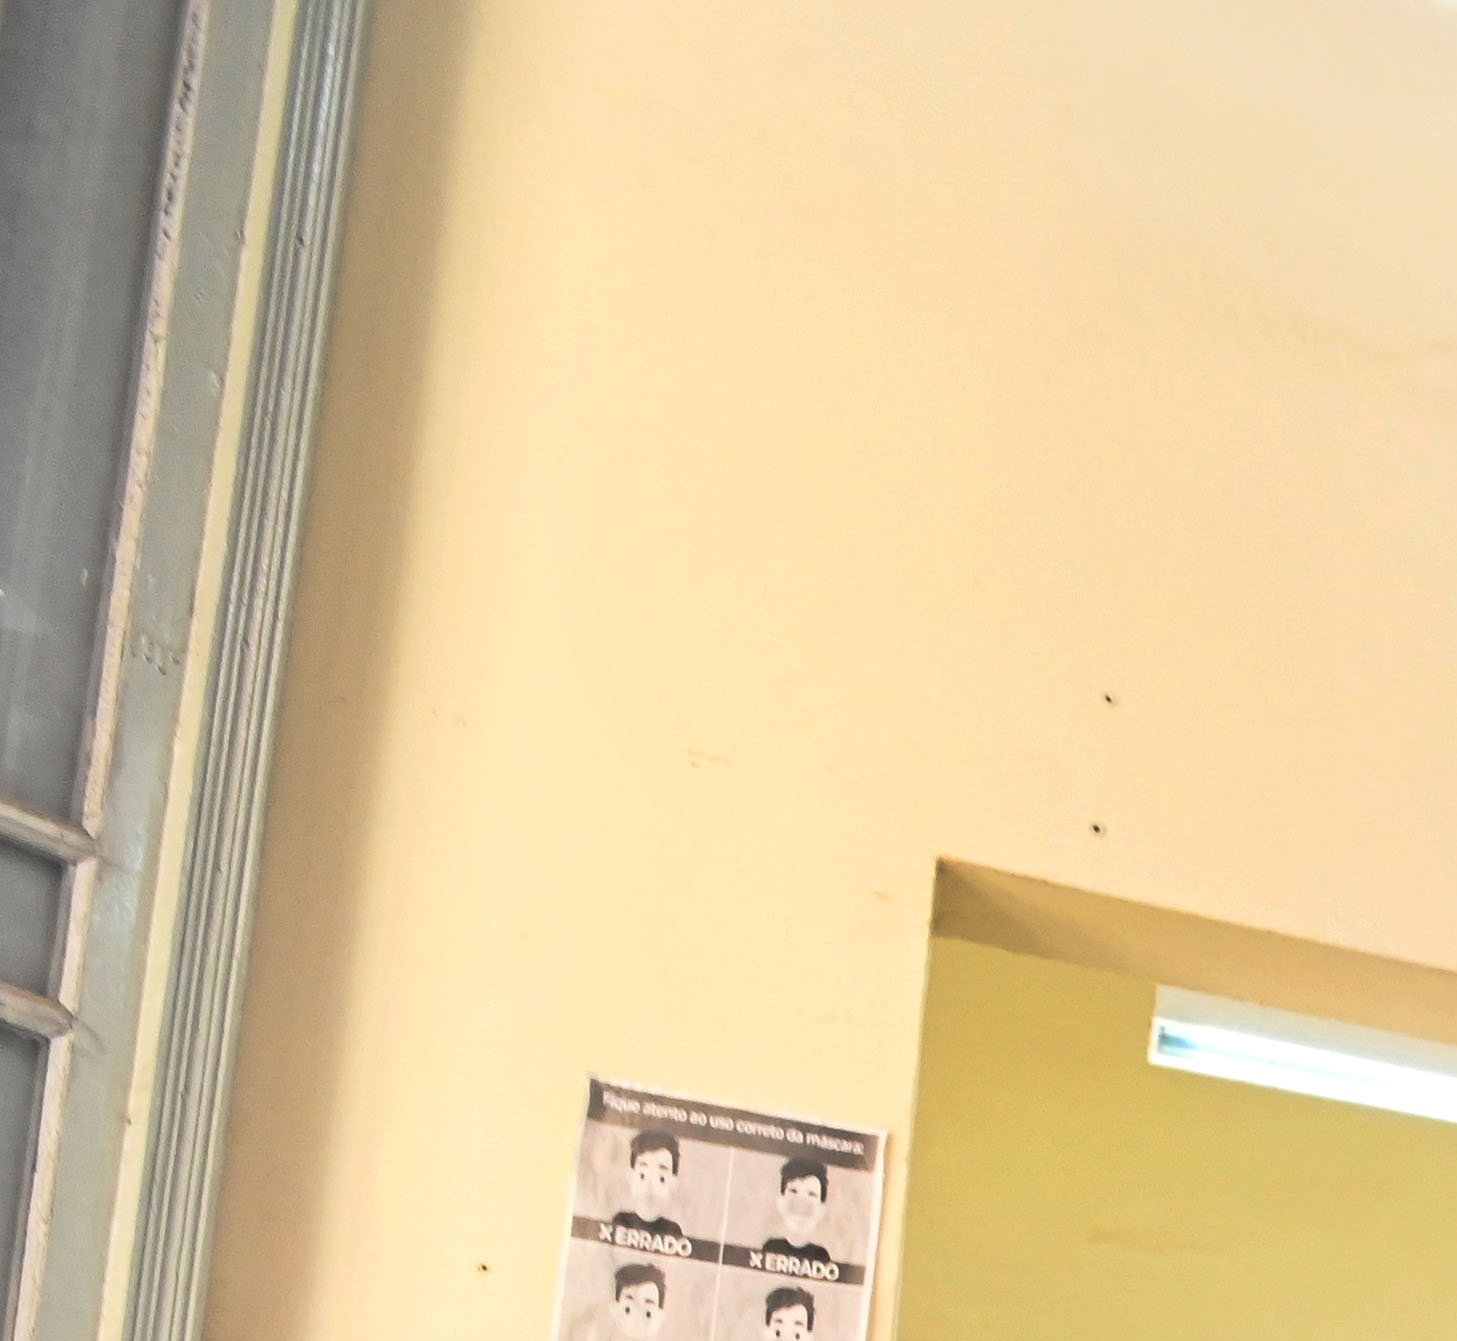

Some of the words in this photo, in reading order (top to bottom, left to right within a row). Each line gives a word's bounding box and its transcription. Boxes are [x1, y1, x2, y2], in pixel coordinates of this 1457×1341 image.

[642, 1101, 688, 1123] atento
[689, 1111, 708, 1127] ao
[709, 1115, 735, 1131] uso
[736, 1119, 785, 1141] correto
[785, 1126, 805, 1144] da
[617, 1227, 693, 1258] ERRADO
[764, 1251, 840, 1282] ERRADO
